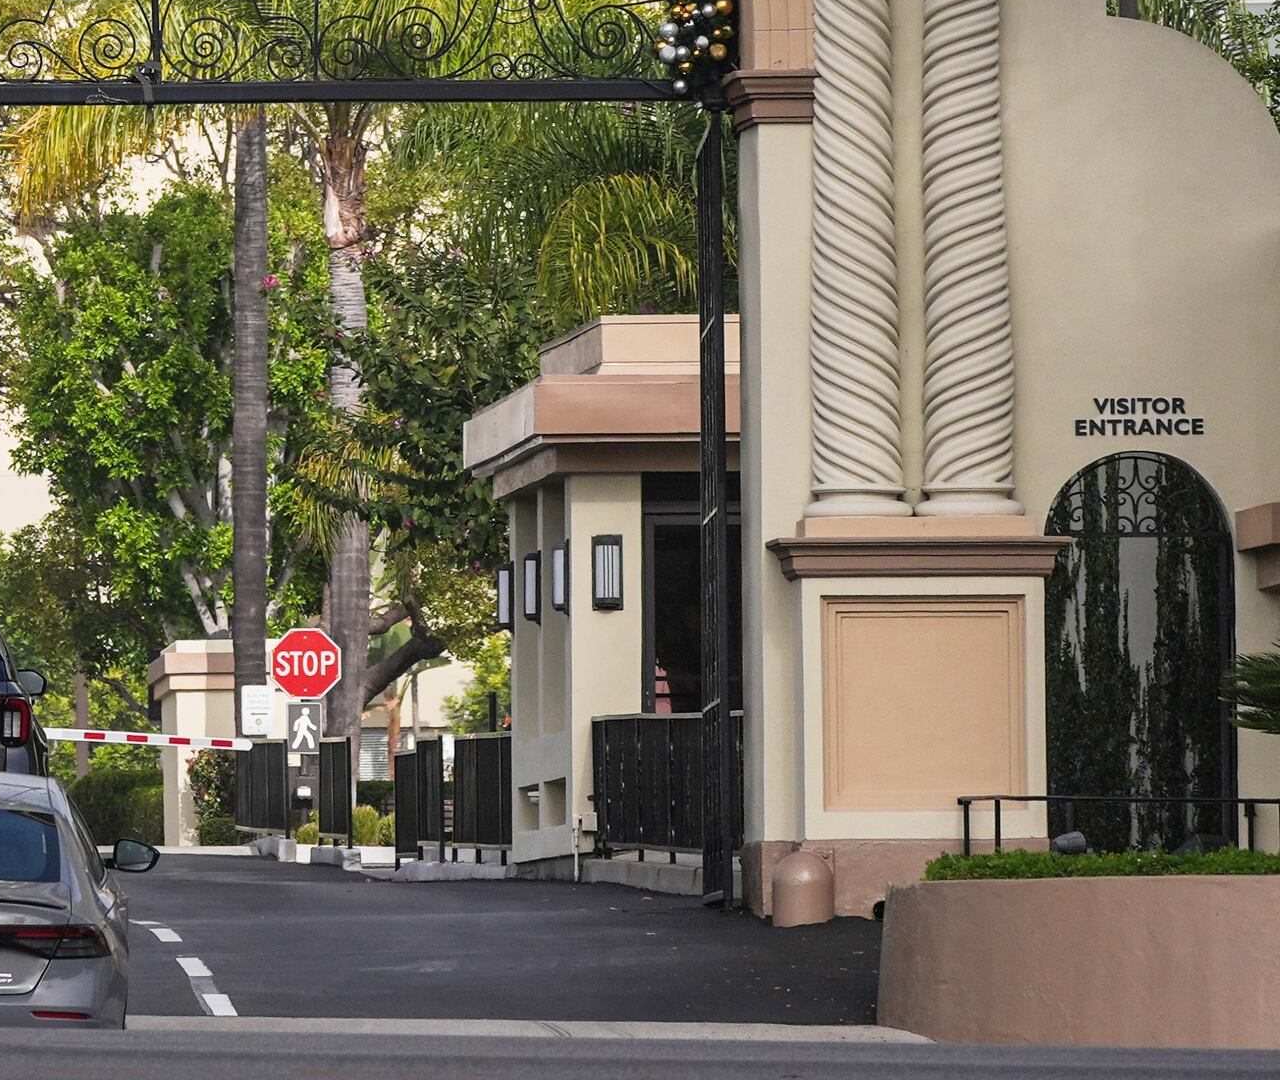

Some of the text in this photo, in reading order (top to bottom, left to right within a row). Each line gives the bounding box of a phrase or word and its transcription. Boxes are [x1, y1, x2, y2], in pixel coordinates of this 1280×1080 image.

[1093, 397, 1186, 415] VISITOR
[1074, 418, 1205, 437] ENTRANCE
[275, 650, 336, 677] STOP
